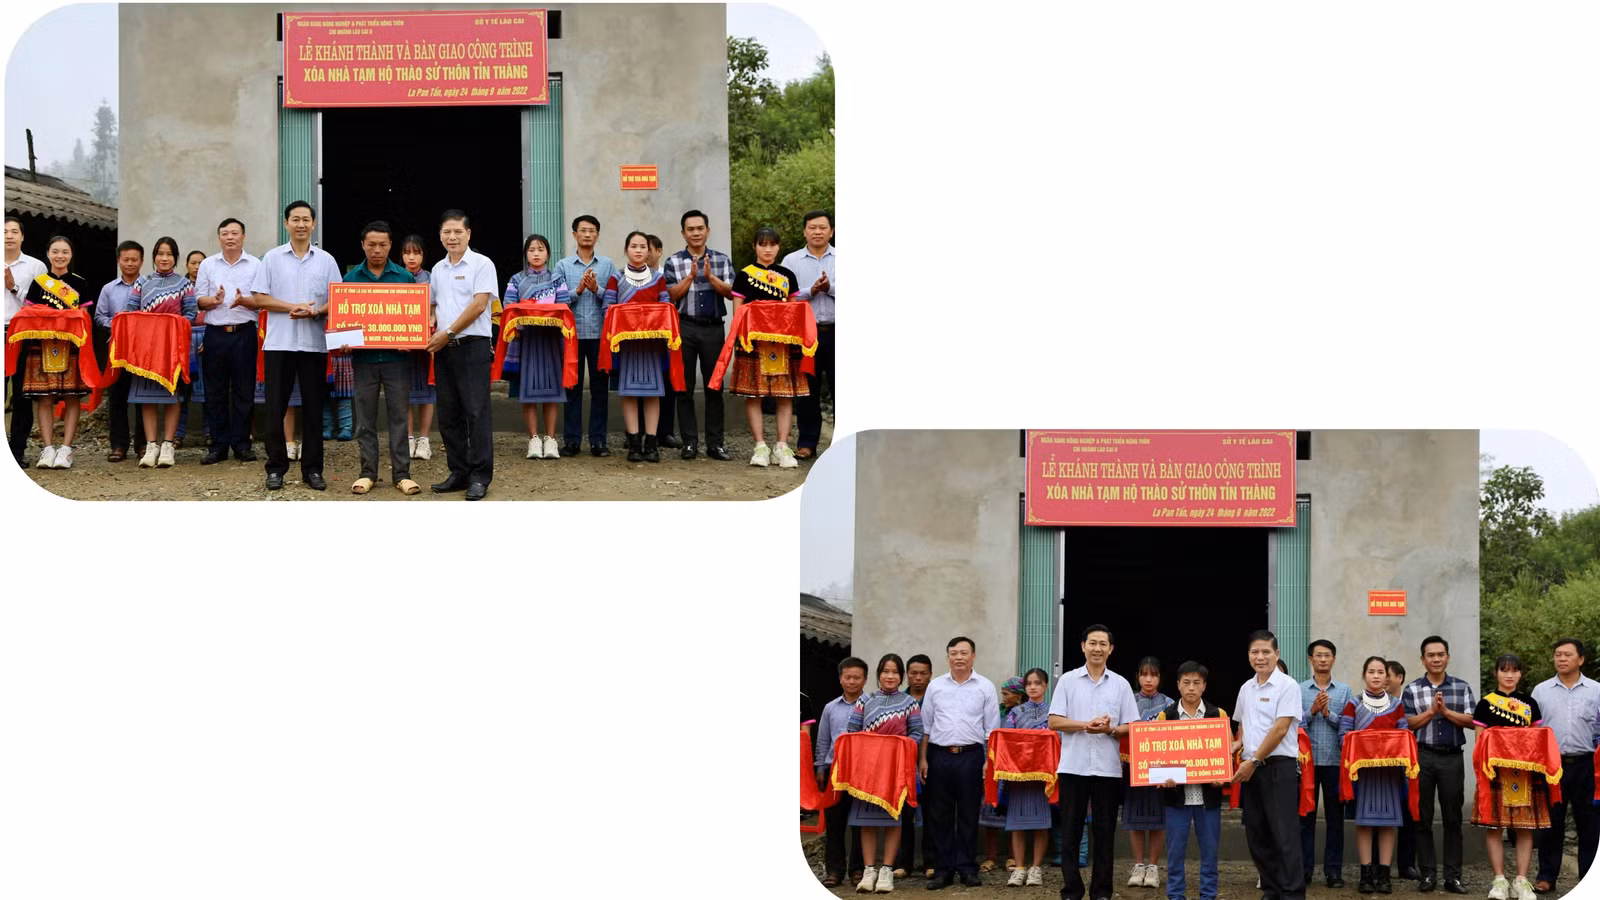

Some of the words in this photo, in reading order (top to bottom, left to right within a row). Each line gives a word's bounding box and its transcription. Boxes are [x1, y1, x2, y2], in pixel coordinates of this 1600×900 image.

[315, 40, 354, 60] KHÁNH
[356, 40, 393, 60] THÀNH
[396, 40, 411, 60] VÀ
[414, 39, 436, 60] BÀN
[438, 42, 465, 59] GIAO
[468, 38, 497, 59] CÔNG
[499, 37, 534, 58] TRÌNH
[304, 65, 325, 82] XÓA
[328, 65, 350, 82] NHÀ
[353, 68, 375, 84] TẠM
[379, 64, 392, 84] HỘ
[395, 64, 422, 81] THÀO
[426, 61, 441, 80] SỬ
[443, 64, 470, 80] THÔN
[473, 61, 490, 80] TỈN
[494, 62, 528, 80] THÀNG
[408, 88, 416, 97] La
[417, 88, 429, 96] Pan
[444, 88, 460, 97] ngày
[471, 87, 489, 97] tháng
[497, 87, 511, 95] năm
[512, 86, 528, 94] 2022
[338, 299, 349, 314] HỖ
[351, 303, 366, 317] TRỢ
[368, 301, 384, 315] XOÁ
[386, 302, 402, 315] NHÀ
[404, 304, 421, 317] TẠM
[368, 324, 407, 332] 30.000.000
[408, 324, 422, 332] VNĐ
[1058, 458, 1098, 478] KHÁNH
[1101, 458, 1139, 479] THÀNH
[1142, 458, 1157, 479] VÀ
[1160, 458, 1182, 479] BÀN
[1184, 462, 1212, 479] GIAO
[1214, 458, 1245, 479] CÔNG
[1247, 458, 1281, 478] TRÌNH
[1046, 482, 1068, 500] XÓA
[1071, 483, 1094, 500] NHÀ
[1097, 486, 1120, 503] TẠM
[1123, 483, 1138, 503] HỘ
[1140, 483, 1168, 500] THÀO
[1171, 481, 1187, 500] SỬ
[1189, 483, 1216, 500] THÔN
[1220, 481, 1237, 500] TỈN
[1240, 483, 1276, 500] THÀNG
[1152, 508, 1161, 517] La
[1161, 508, 1174, 517] Pan
[1190, 508, 1205, 518] ngày
[1206, 508, 1214, 517] 24
[1217, 508, 1235, 518] tháng
[1244, 508, 1258, 517] năm
[1259, 507, 1275, 516] 2022
[1140, 738, 1150, 752] HỖ
[1152, 740, 1167, 754] TRỢ
[1169, 738, 1184, 751] XOÁ
[1187, 736, 1203, 749] NHÀ
[1205, 738, 1222, 751] TẠM
[1138, 758, 1148, 769] SỐ
